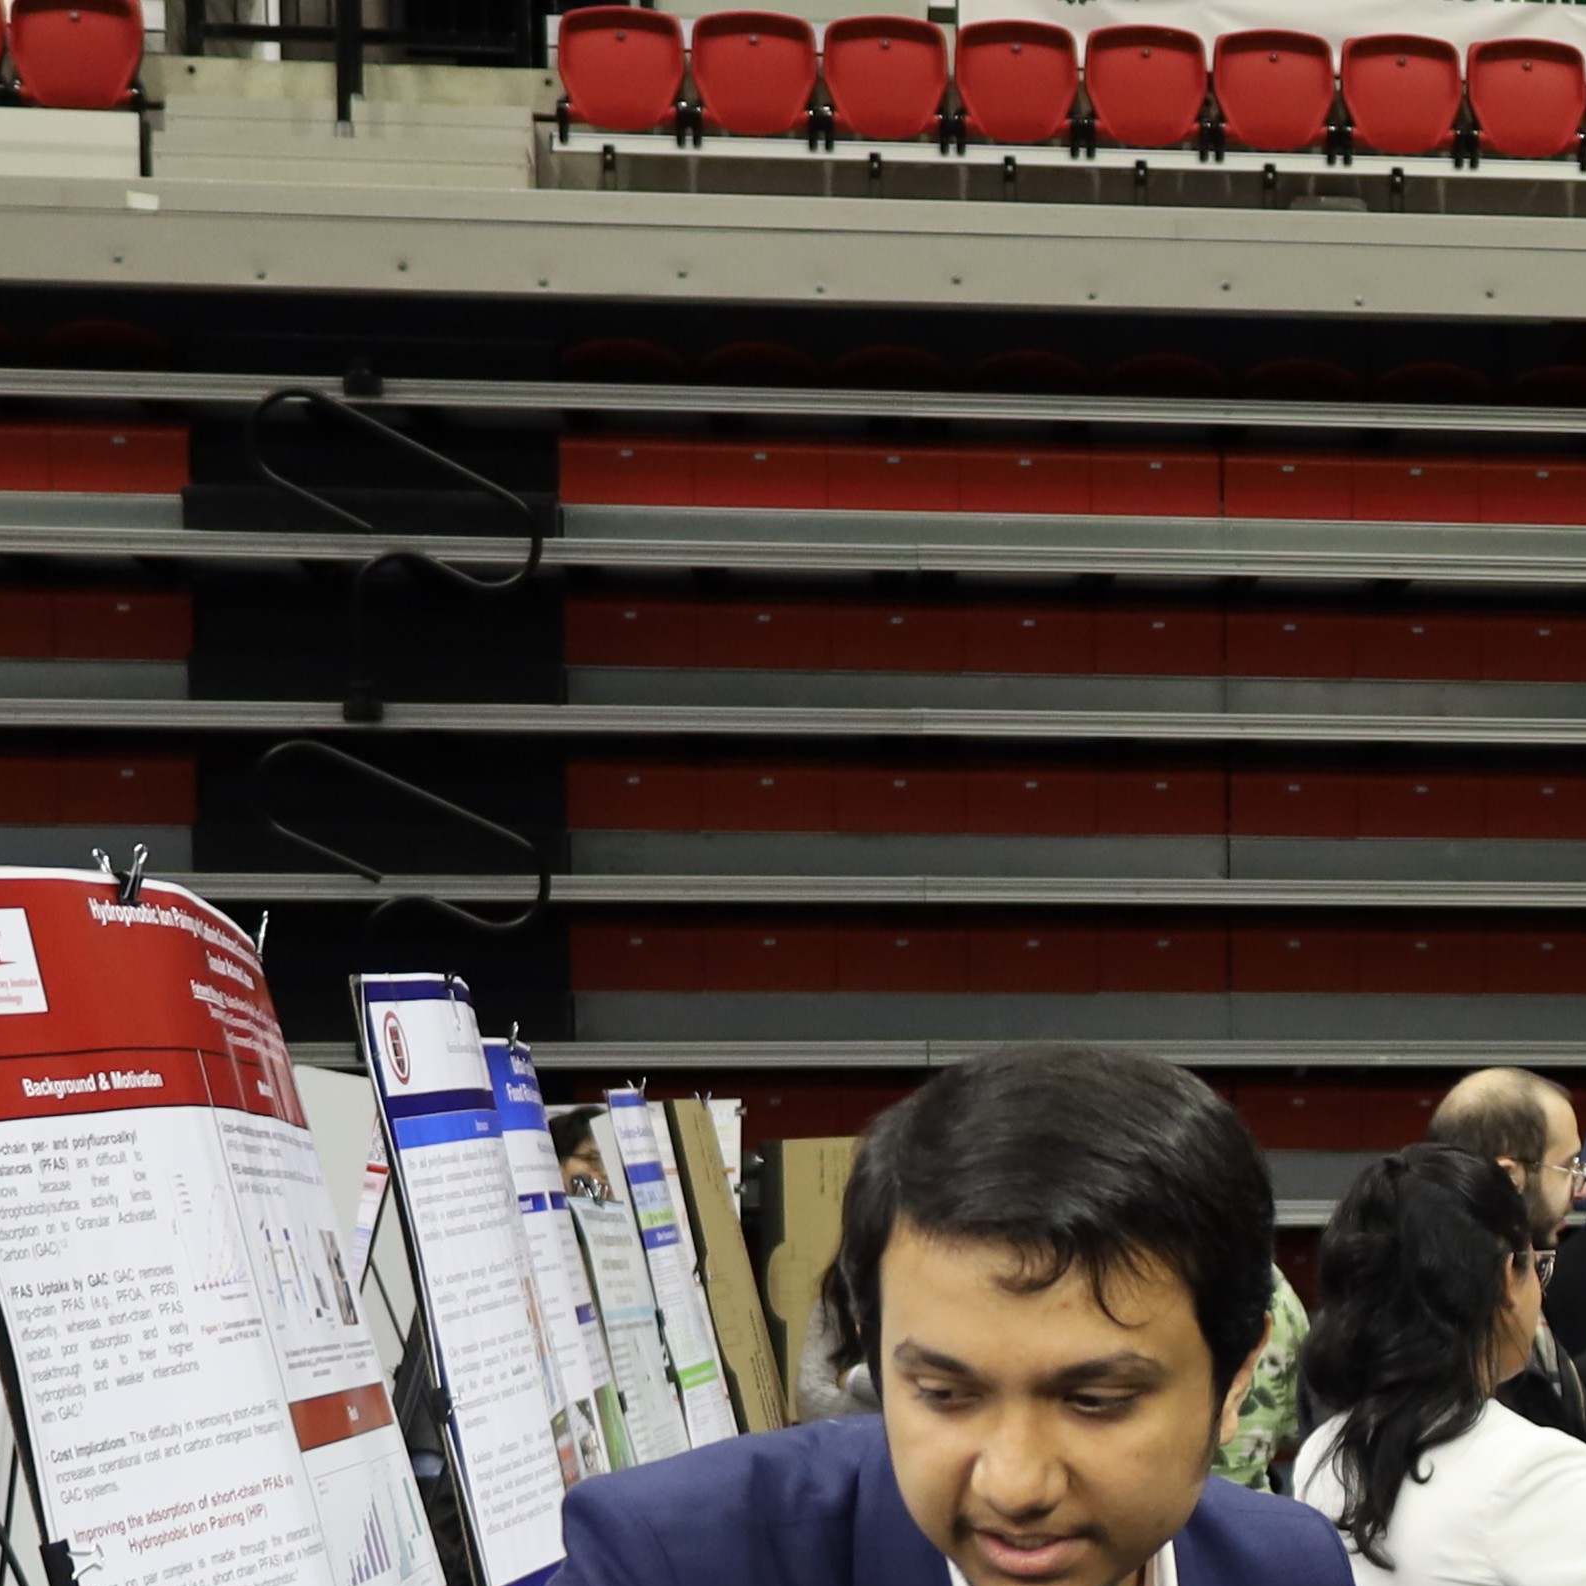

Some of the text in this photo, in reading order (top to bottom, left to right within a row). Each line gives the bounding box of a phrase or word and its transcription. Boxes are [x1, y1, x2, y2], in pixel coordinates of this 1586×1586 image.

[157, 904, 176, 926] Ion
[22, 1068, 164, 1101] Background & Motivation
[32, 1138, 49, 1154] per-
[53, 1136, 69, 1151] and
[73, 1517, 126, 1545] Improving
[127, 1512, 144, 1529] the
[145, 1500, 196, 1526] adsorption
[198, 1494, 209, 1510] of
[210, 1480, 263, 1507] short-chain
[128, 1525, 189, 1554] Hydrophobic
[190, 1520, 209, 1536] Ion
[209, 1509, 246, 1532] Pairing
